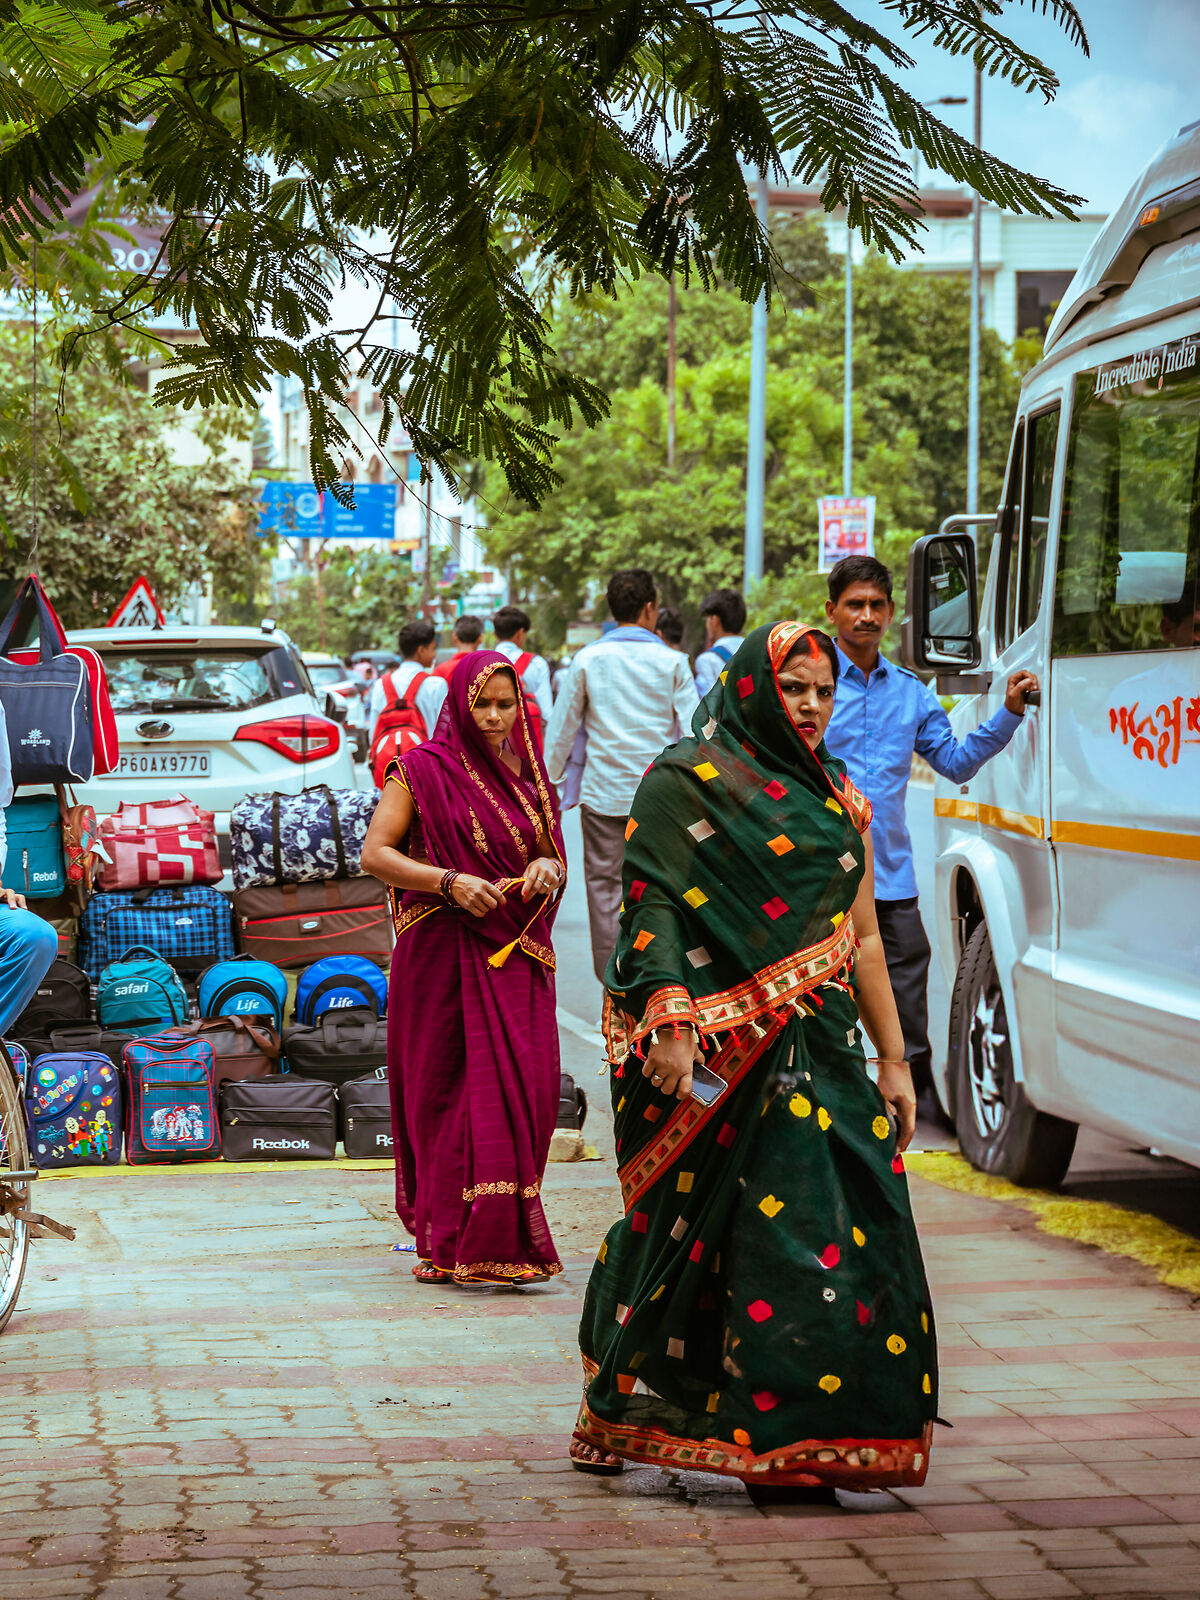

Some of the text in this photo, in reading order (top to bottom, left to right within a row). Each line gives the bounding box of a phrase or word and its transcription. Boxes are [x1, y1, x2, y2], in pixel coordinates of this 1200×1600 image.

[1093, 349, 1160, 395] Incredible
[114, 756, 208, 773] P60AX9770
[114, 981, 149, 996] safari
[236, 999, 260, 1012] Life
[328, 996, 354, 1009] Life
[252, 1138, 311, 1150] Reebok
